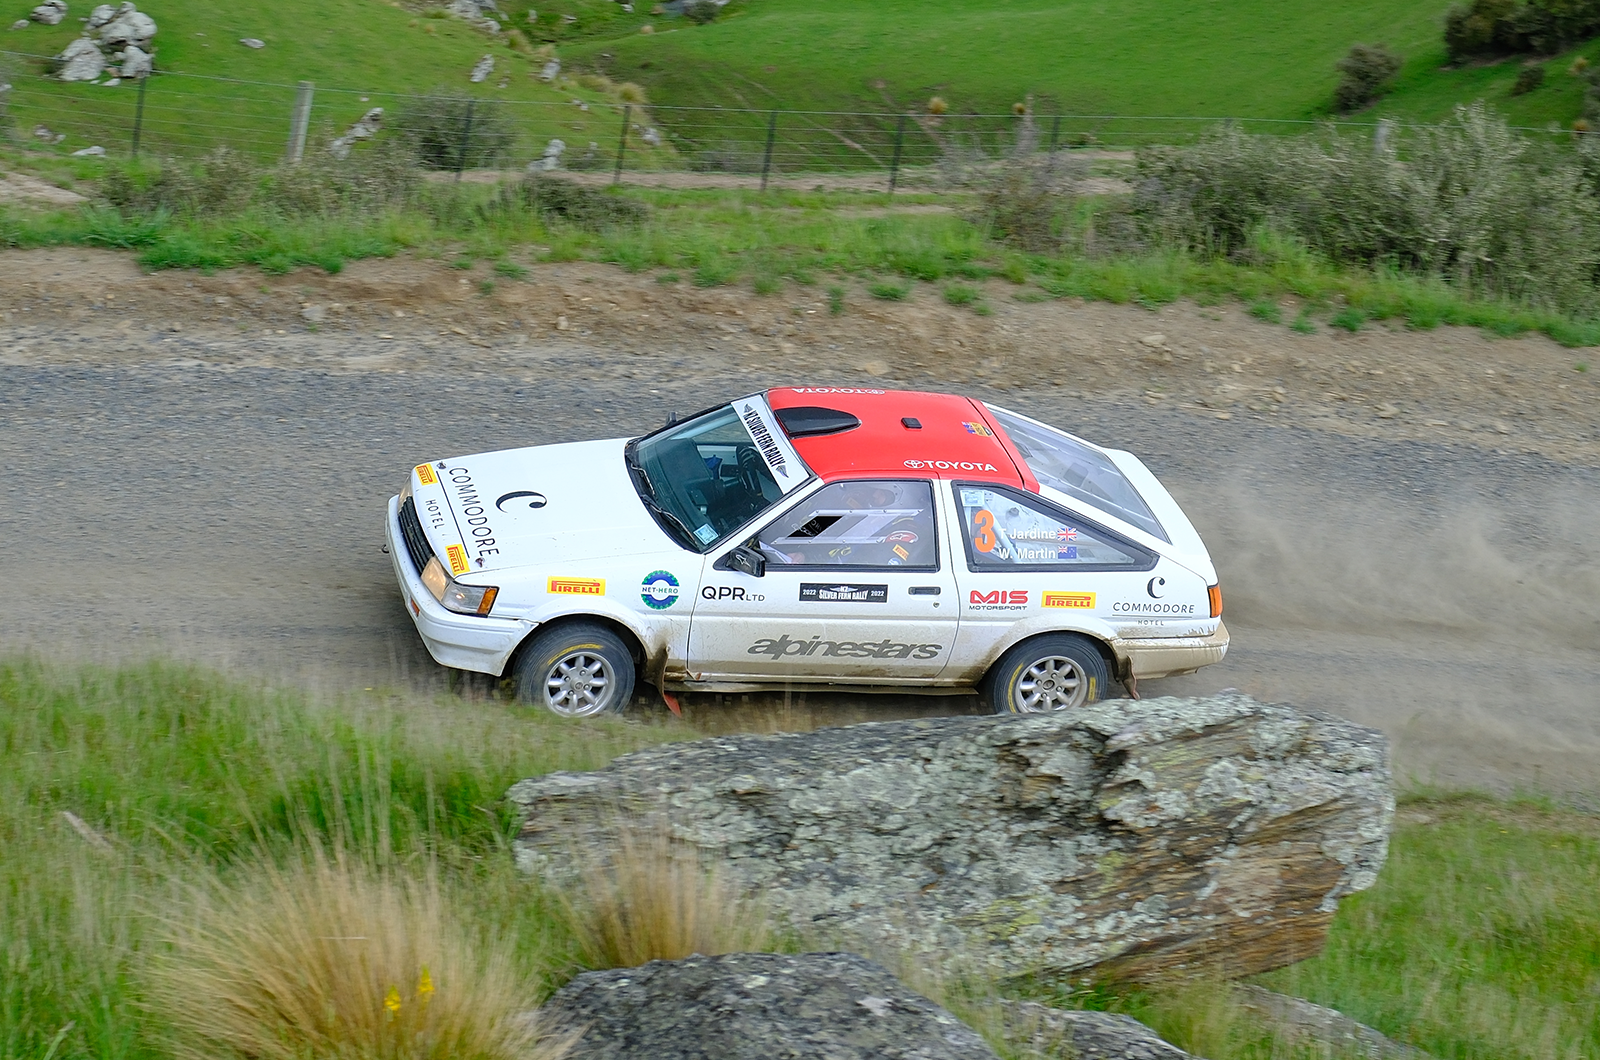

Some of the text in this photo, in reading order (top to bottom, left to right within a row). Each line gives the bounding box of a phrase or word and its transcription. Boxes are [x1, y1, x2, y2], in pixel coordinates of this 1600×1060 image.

[746, 416, 768, 438] SILVER
[756, 432, 776, 451] FERN
[763, 446, 786, 468] RALLY
[924, 460, 998, 472] TOYOTA
[416, 464, 433, 483] PIRELLI
[496, 490, 548, 513] C
[426, 499, 445, 529] HOTEL
[448, 467, 499, 557] COMMODORE
[974, 509, 996, 553] 3
[1009, 528, 1056, 540] Jardine
[447, 545, 465, 573] PIRELLI
[1017, 546, 1056, 559] Martin
[550, 580, 601, 595] PIRELLI
[641, 586, 679, 594] NET-HERO
[702, 586, 765, 602] QPR LTD
[818, 589, 869, 600] SILVER FERN RALLY
[1146, 576, 1166, 599] C
[1045, 594, 1092, 608] PIRELLI
[1112, 601, 1195, 614] COMMODORE
[747, 634, 943, 660] alpinestars
